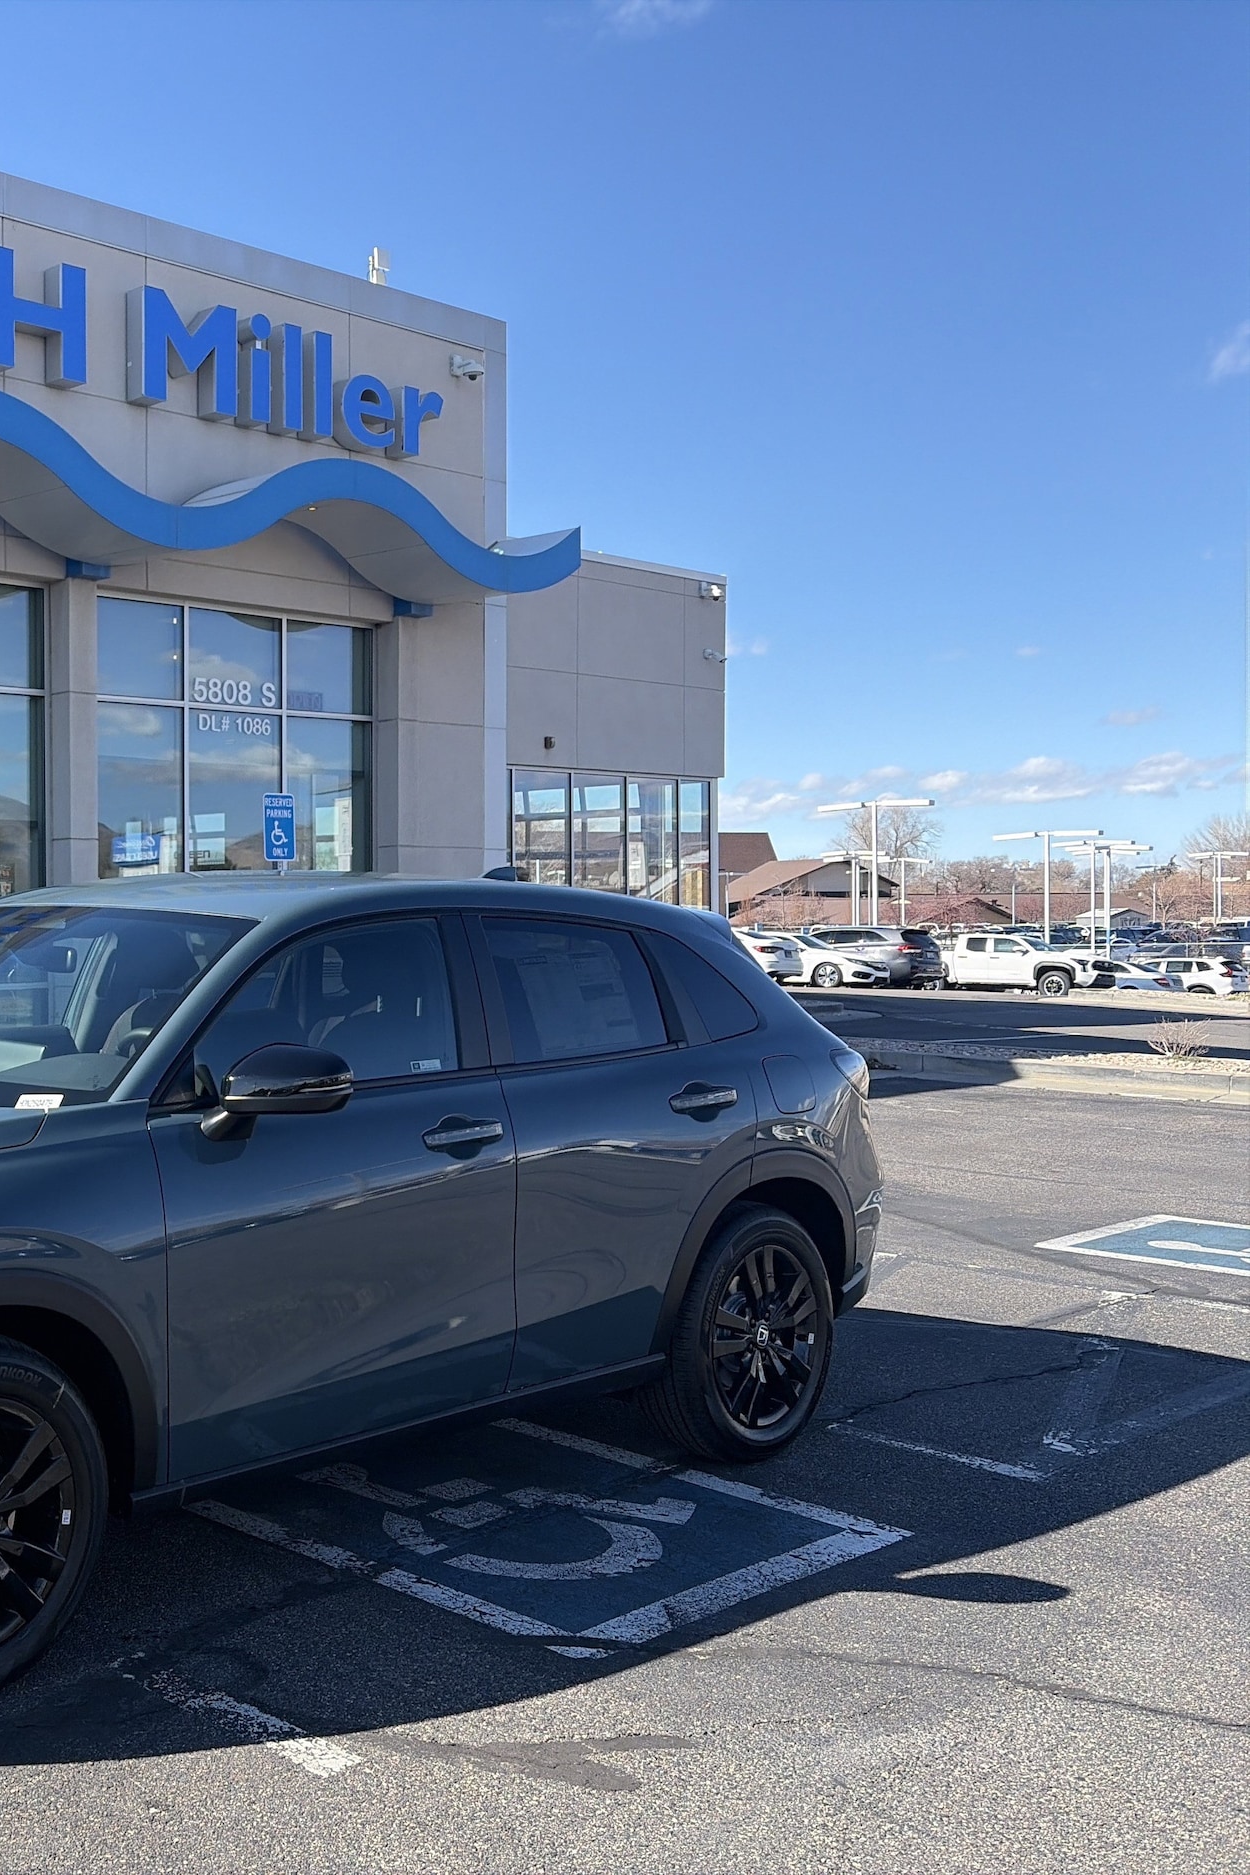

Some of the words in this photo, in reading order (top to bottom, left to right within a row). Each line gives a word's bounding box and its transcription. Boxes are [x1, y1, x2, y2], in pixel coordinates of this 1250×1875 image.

[127, 284, 443, 459] Miller
[193, 677, 252, 706] 5808
[261, 682, 276, 708] S
[198, 713, 231, 732] DL#
[236, 716, 271, 736] 1086
[265, 797, 293, 807] RESERVED
[266, 808, 292, 818] PARKING
[272, 847, 288, 857] ONLY
